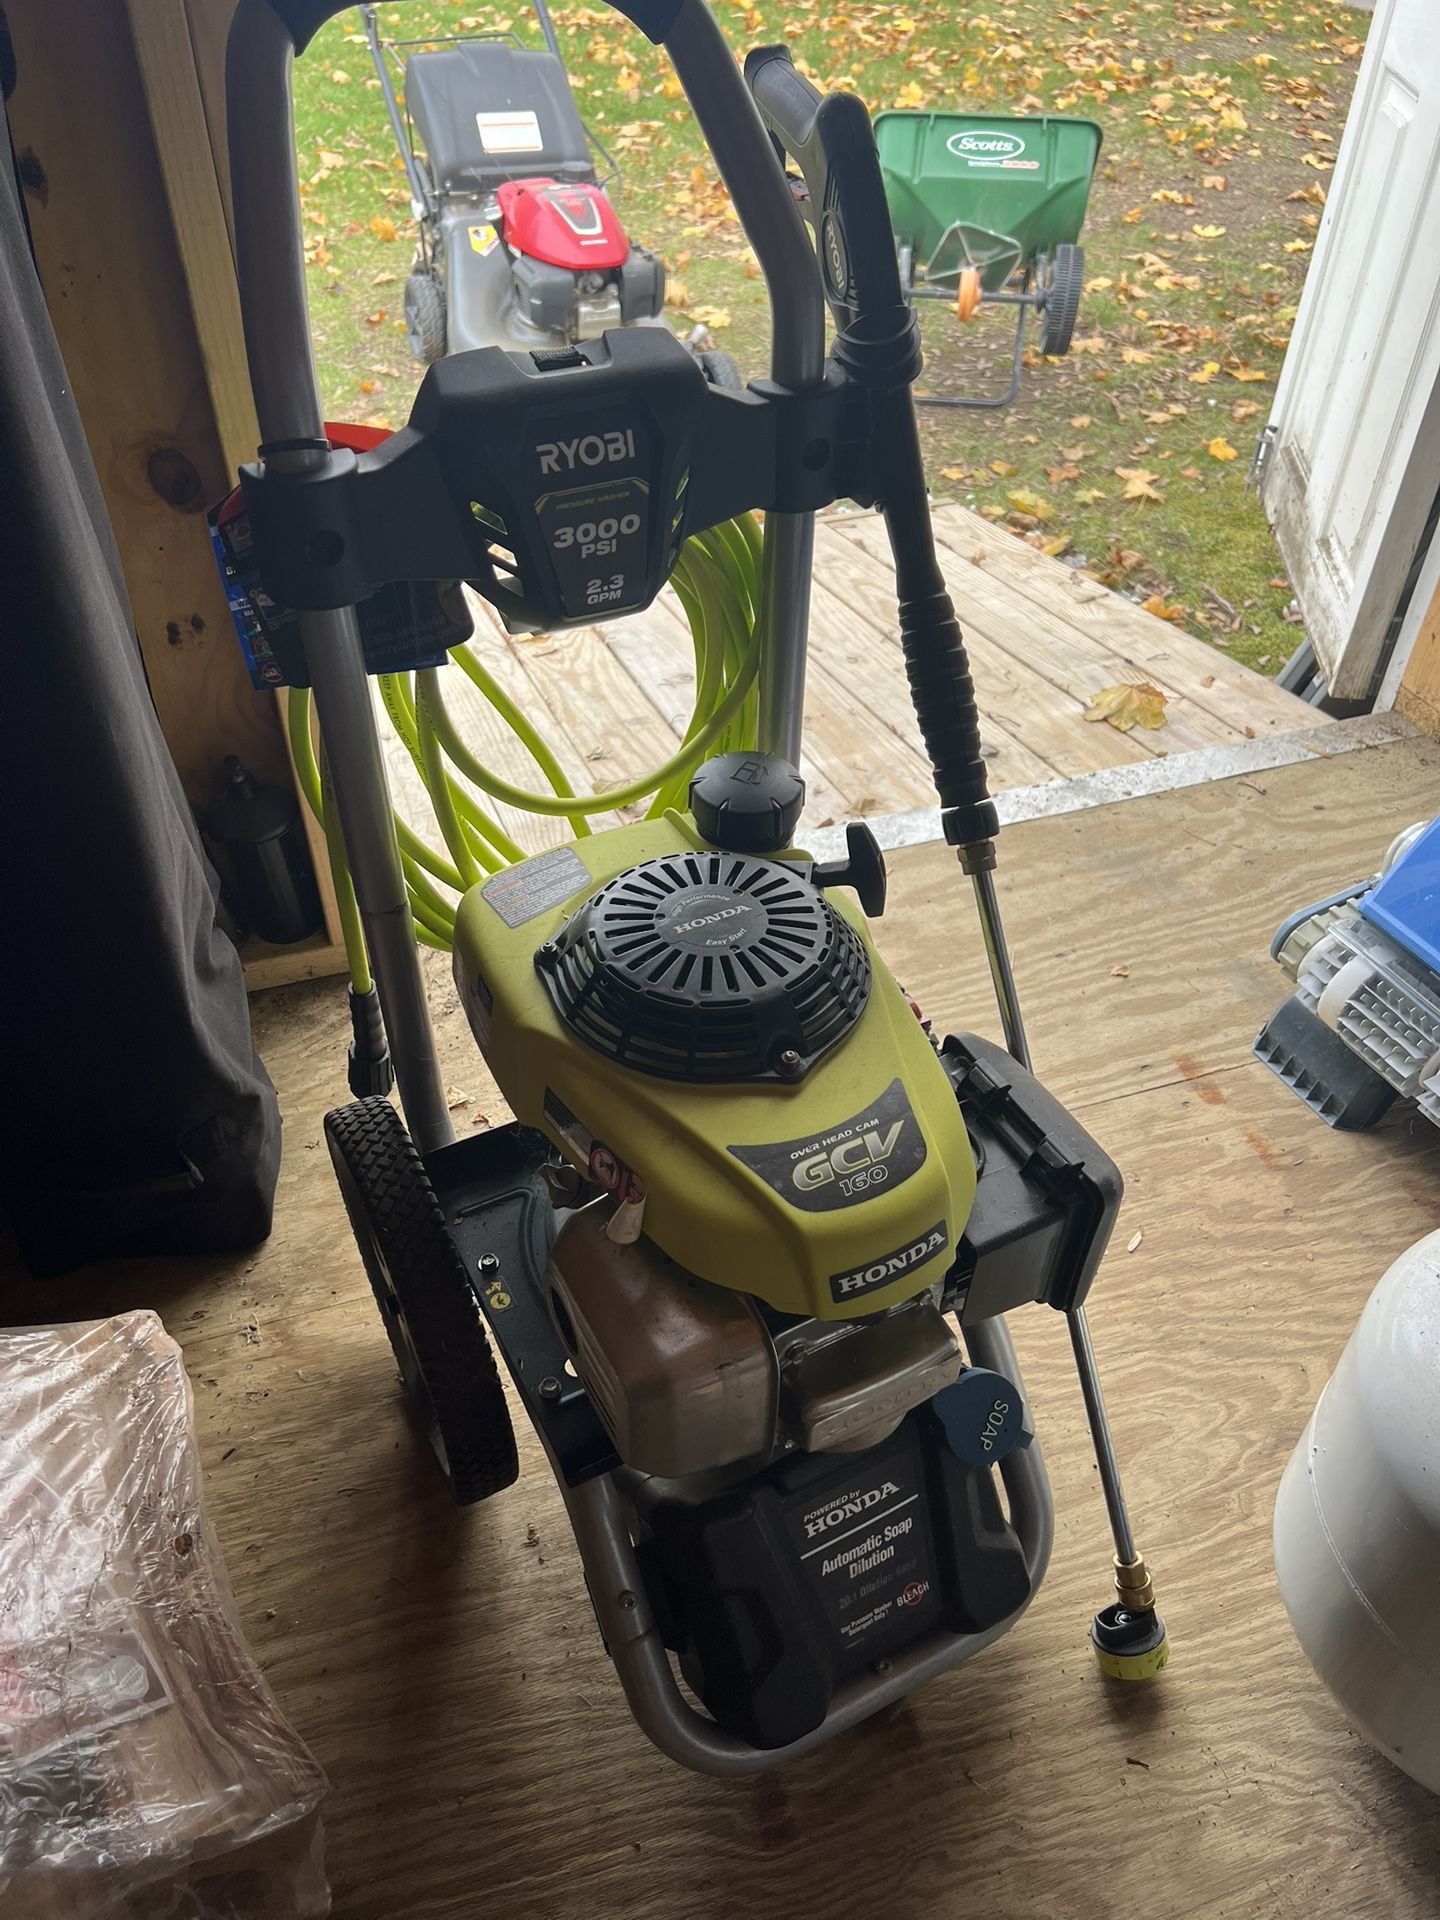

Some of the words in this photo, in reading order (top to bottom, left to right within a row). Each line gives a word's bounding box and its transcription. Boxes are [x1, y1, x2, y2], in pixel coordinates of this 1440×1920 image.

[958, 137, 1014, 151] Scotts
[826, 220, 845, 289] RYOBI
[535, 429, 636, 475] RYOBI
[552, 514, 641, 549] 3000
[581, 539, 617, 560] PSI
[586, 574, 625, 595] 2.3
[587, 589, 623, 605] GPM
[681, 893, 731, 907] Performance
[673, 904, 753, 934] HONDA
[728, 927, 747, 942] Start
[789, 1142, 821, 1161] OVER
[822, 1127, 853, 1148] HEAD
[855, 1117, 880, 1134] CAM
[792, 1118, 905, 1192] GCV
[838, 1163, 890, 1197] 160
[838, 1230, 947, 1294] HONDA
[980, 1400, 1009, 1452] SOAP
[803, 1494, 849, 1523] POWERED
[848, 1488, 861, 1503] by
[803, 1480, 901, 1538] HONDA
[821, 1531, 883, 1577] Automatic
[883, 1516, 914, 1543] Soap
[849, 1544, 896, 1580] Dilution
[896, 1580, 931, 1607] BLEACH
